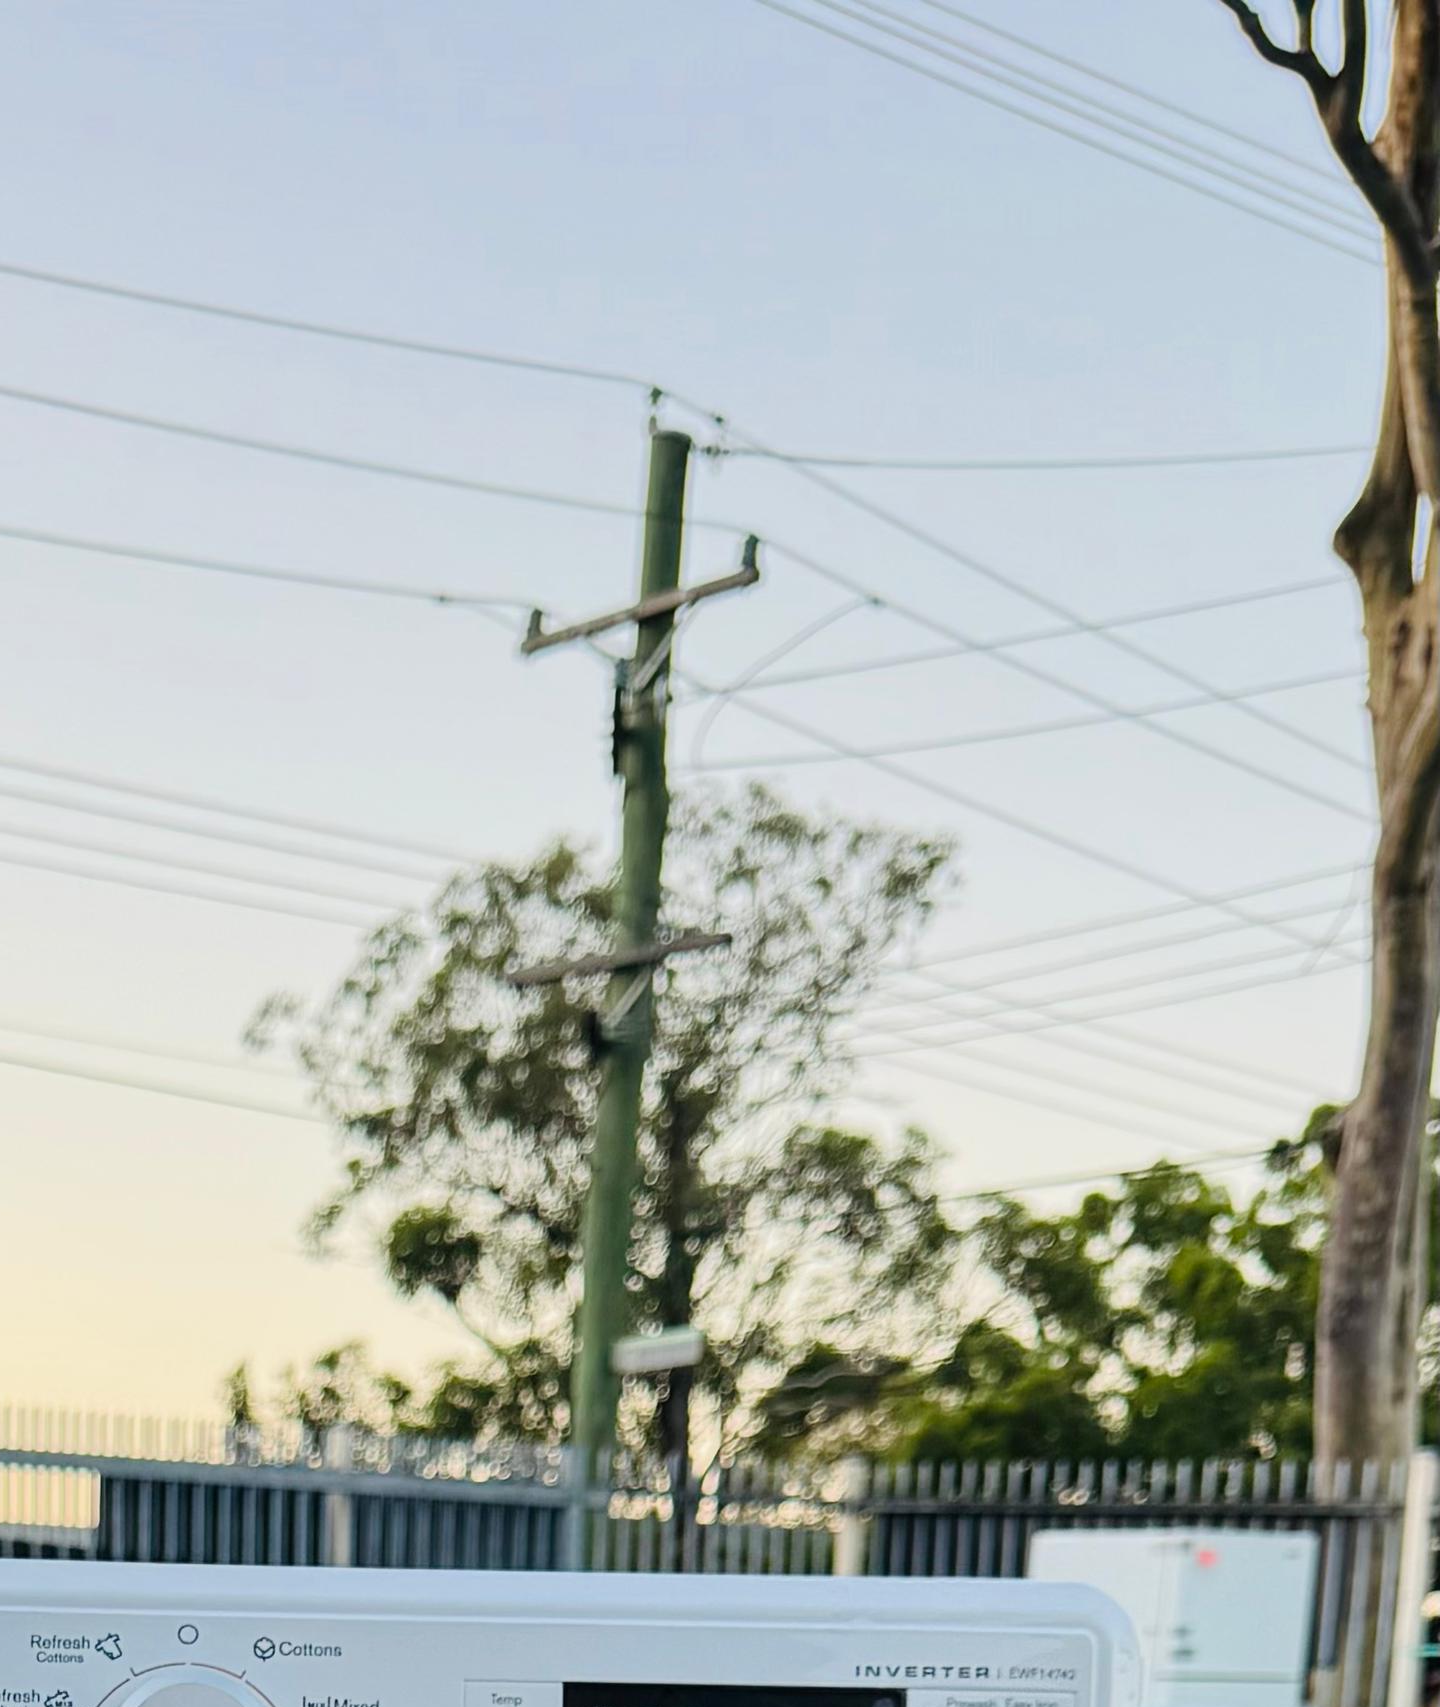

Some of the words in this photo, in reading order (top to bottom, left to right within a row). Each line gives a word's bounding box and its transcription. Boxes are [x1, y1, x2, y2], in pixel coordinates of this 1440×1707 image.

[30, 1633, 91, 1652] Refresh
[279, 1641, 343, 1658] Cottons
[36, 1652, 85, 1665] Cottons
[855, 1665, 991, 1680] INVERTER
[491, 1693, 523, 1707] Temp
